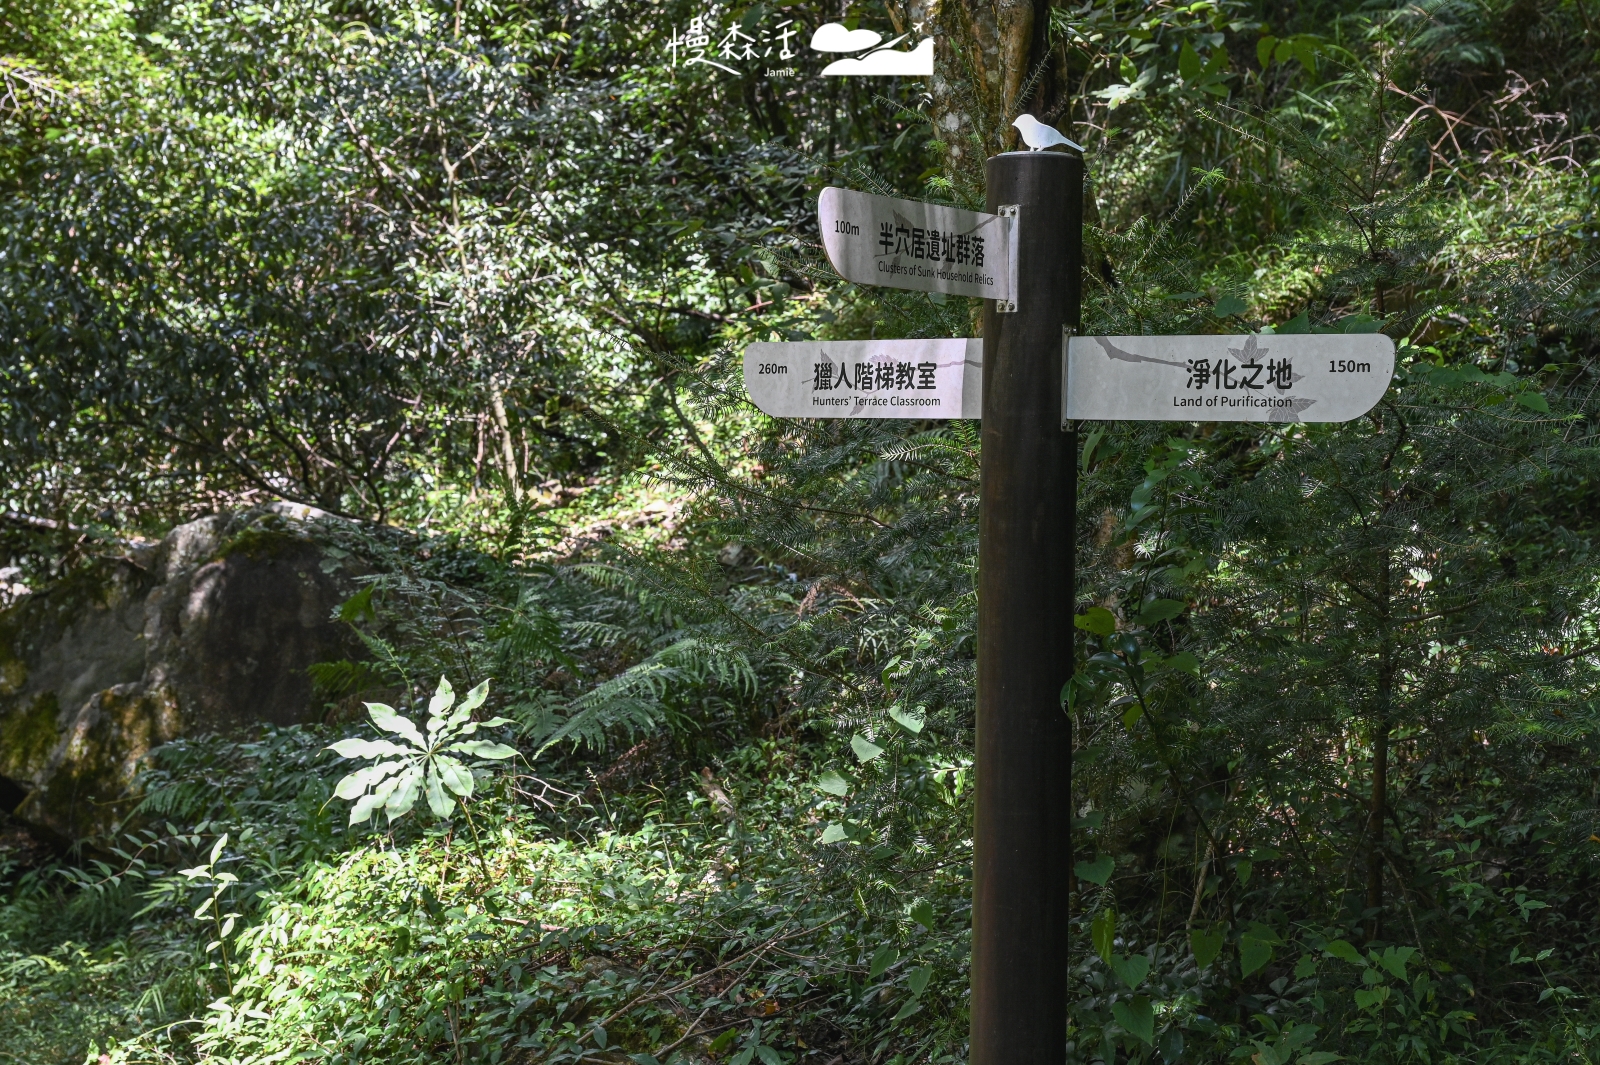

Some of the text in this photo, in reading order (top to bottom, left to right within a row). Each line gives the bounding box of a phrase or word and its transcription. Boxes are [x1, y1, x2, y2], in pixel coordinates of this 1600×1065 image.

[834, 219, 860, 236] 100m
[878, 221, 985, 268] 半穴居遺址群落
[878, 260, 994, 286] Clusters of Sunk Household Relics
[758, 363, 788, 375] 260m
[1186, 357, 1293, 390] 淨化之地
[1328, 360, 1371, 373] 150m
[813, 361, 937, 391] 獵人階梯教室
[854, 396, 888, 406] Terrace
[890, 396, 941, 406] Classroom
[1173, 396, 1292, 407] Land of Purification
